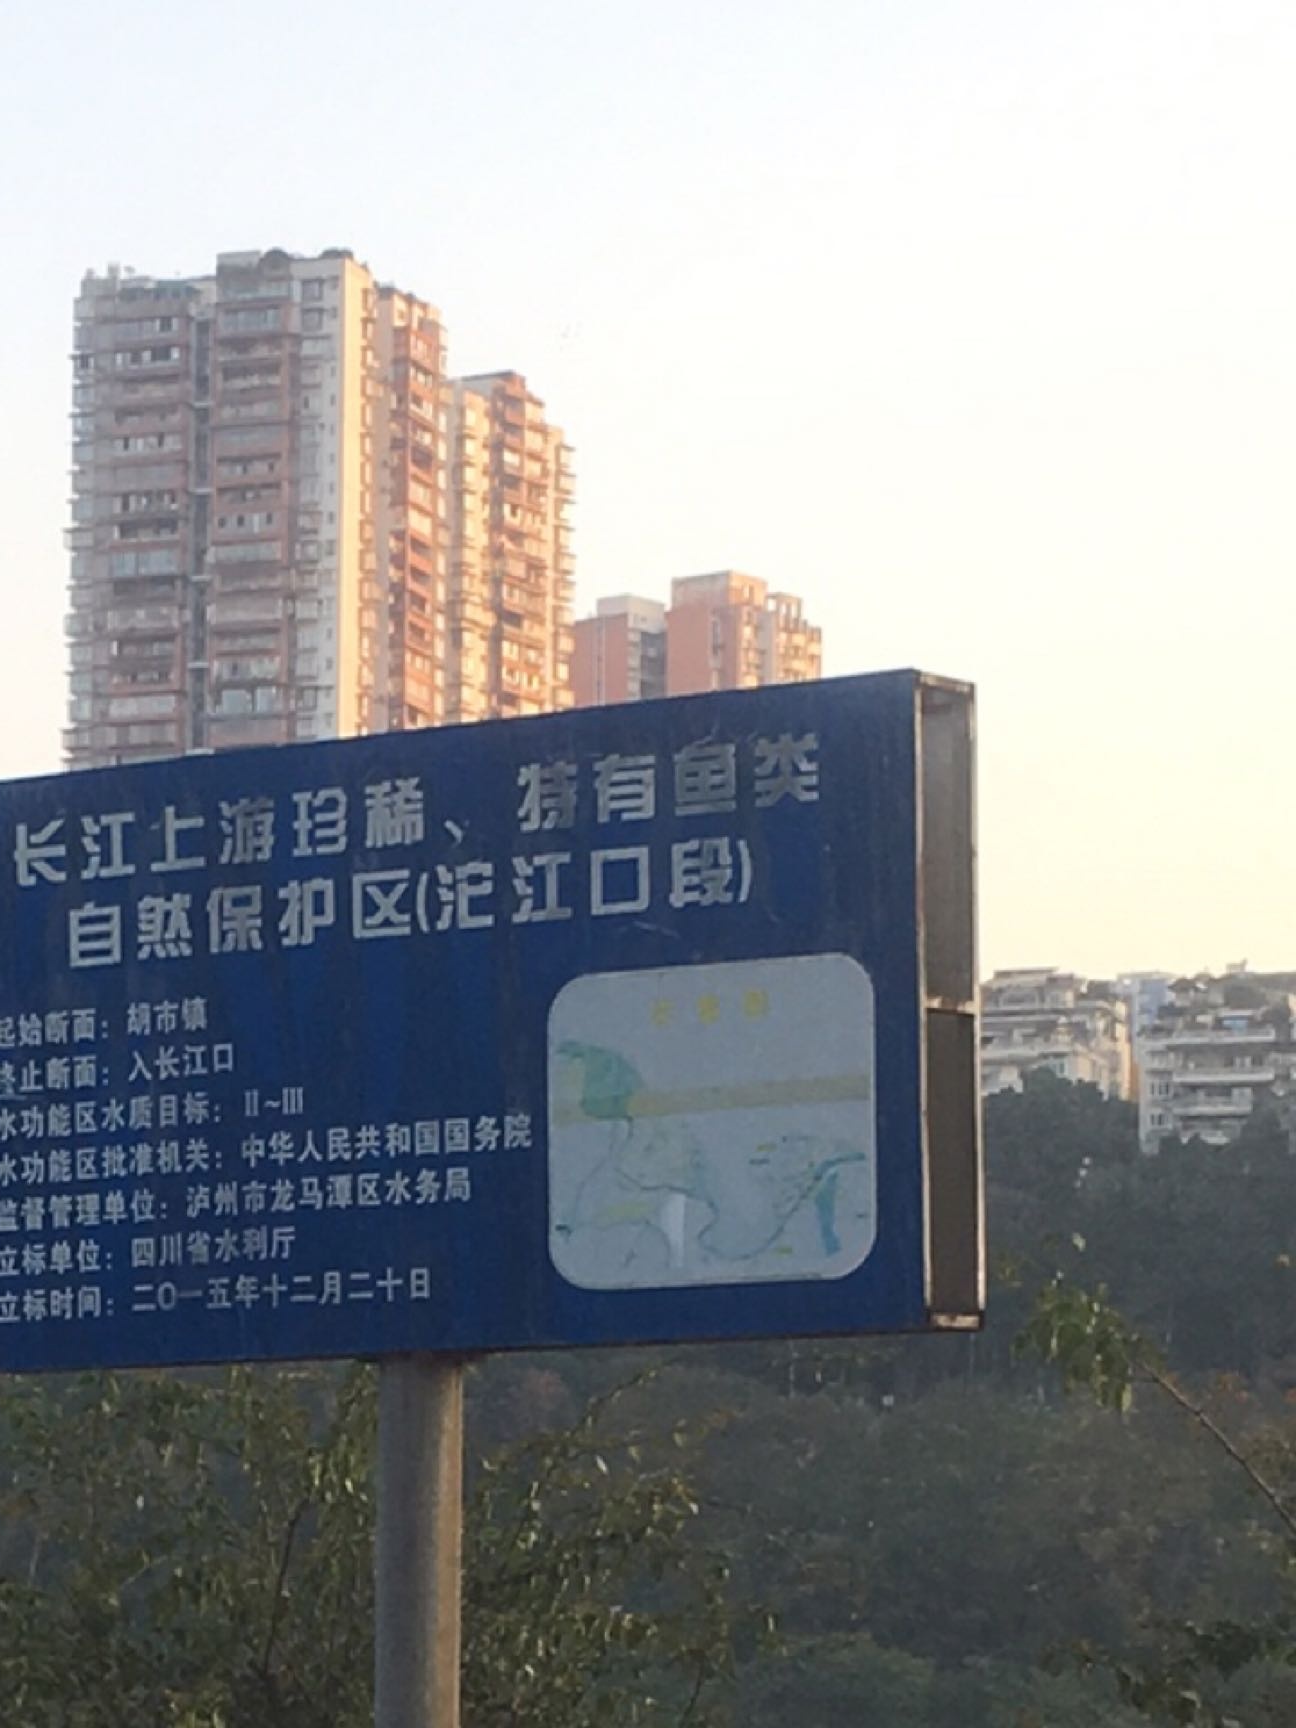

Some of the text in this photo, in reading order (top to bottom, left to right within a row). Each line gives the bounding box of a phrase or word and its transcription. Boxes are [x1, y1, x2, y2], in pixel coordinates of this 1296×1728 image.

[13, 732, 820, 886] 长江上游珍稀、特有鱼类
